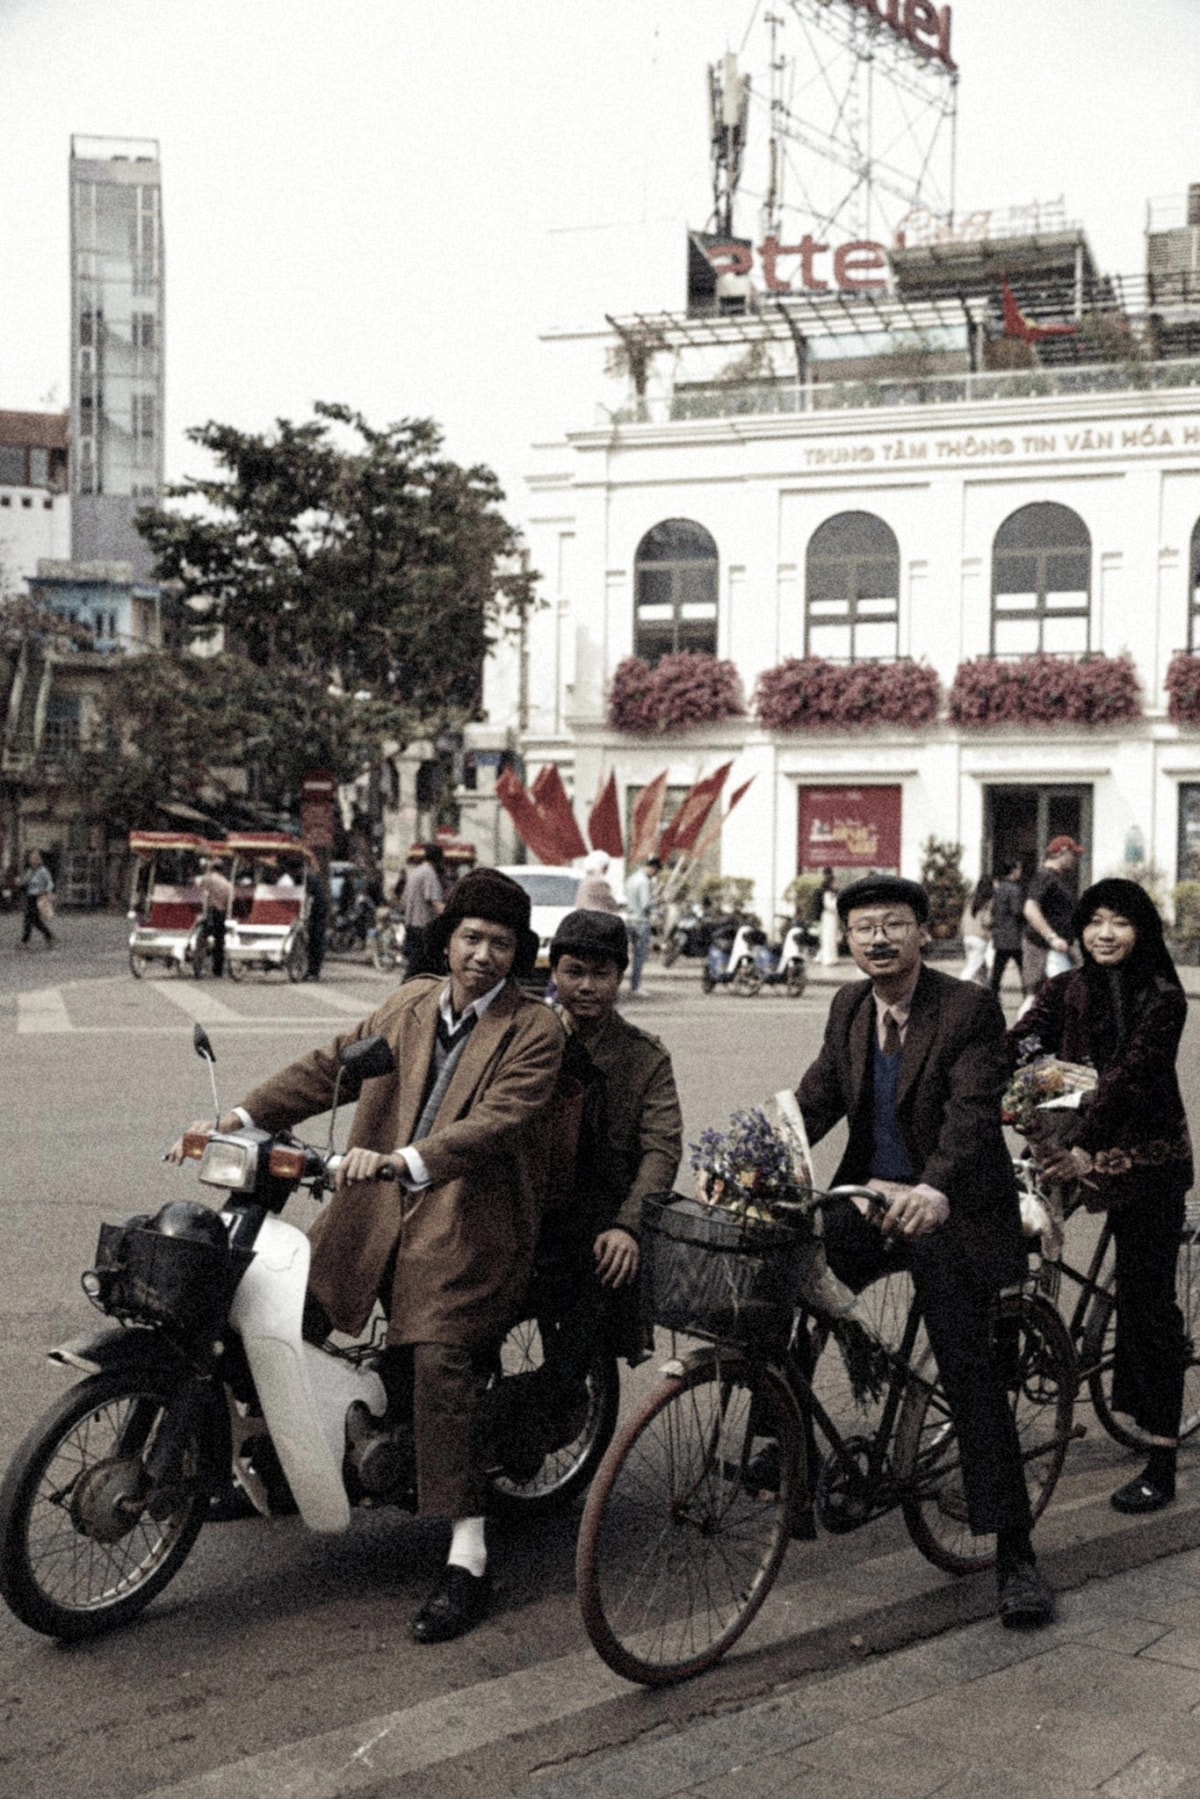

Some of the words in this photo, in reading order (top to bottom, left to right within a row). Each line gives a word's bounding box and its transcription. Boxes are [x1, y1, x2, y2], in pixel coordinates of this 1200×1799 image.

[804, 444, 876, 465] TRUNG
[882, 438, 928, 461] TÂM
[936, 434, 1014, 457] THÔNG
[1021, 434, 1056, 454] TIN
[1064, 428, 1113, 451] VĂN
[1121, 423, 1174, 447] HÓA
